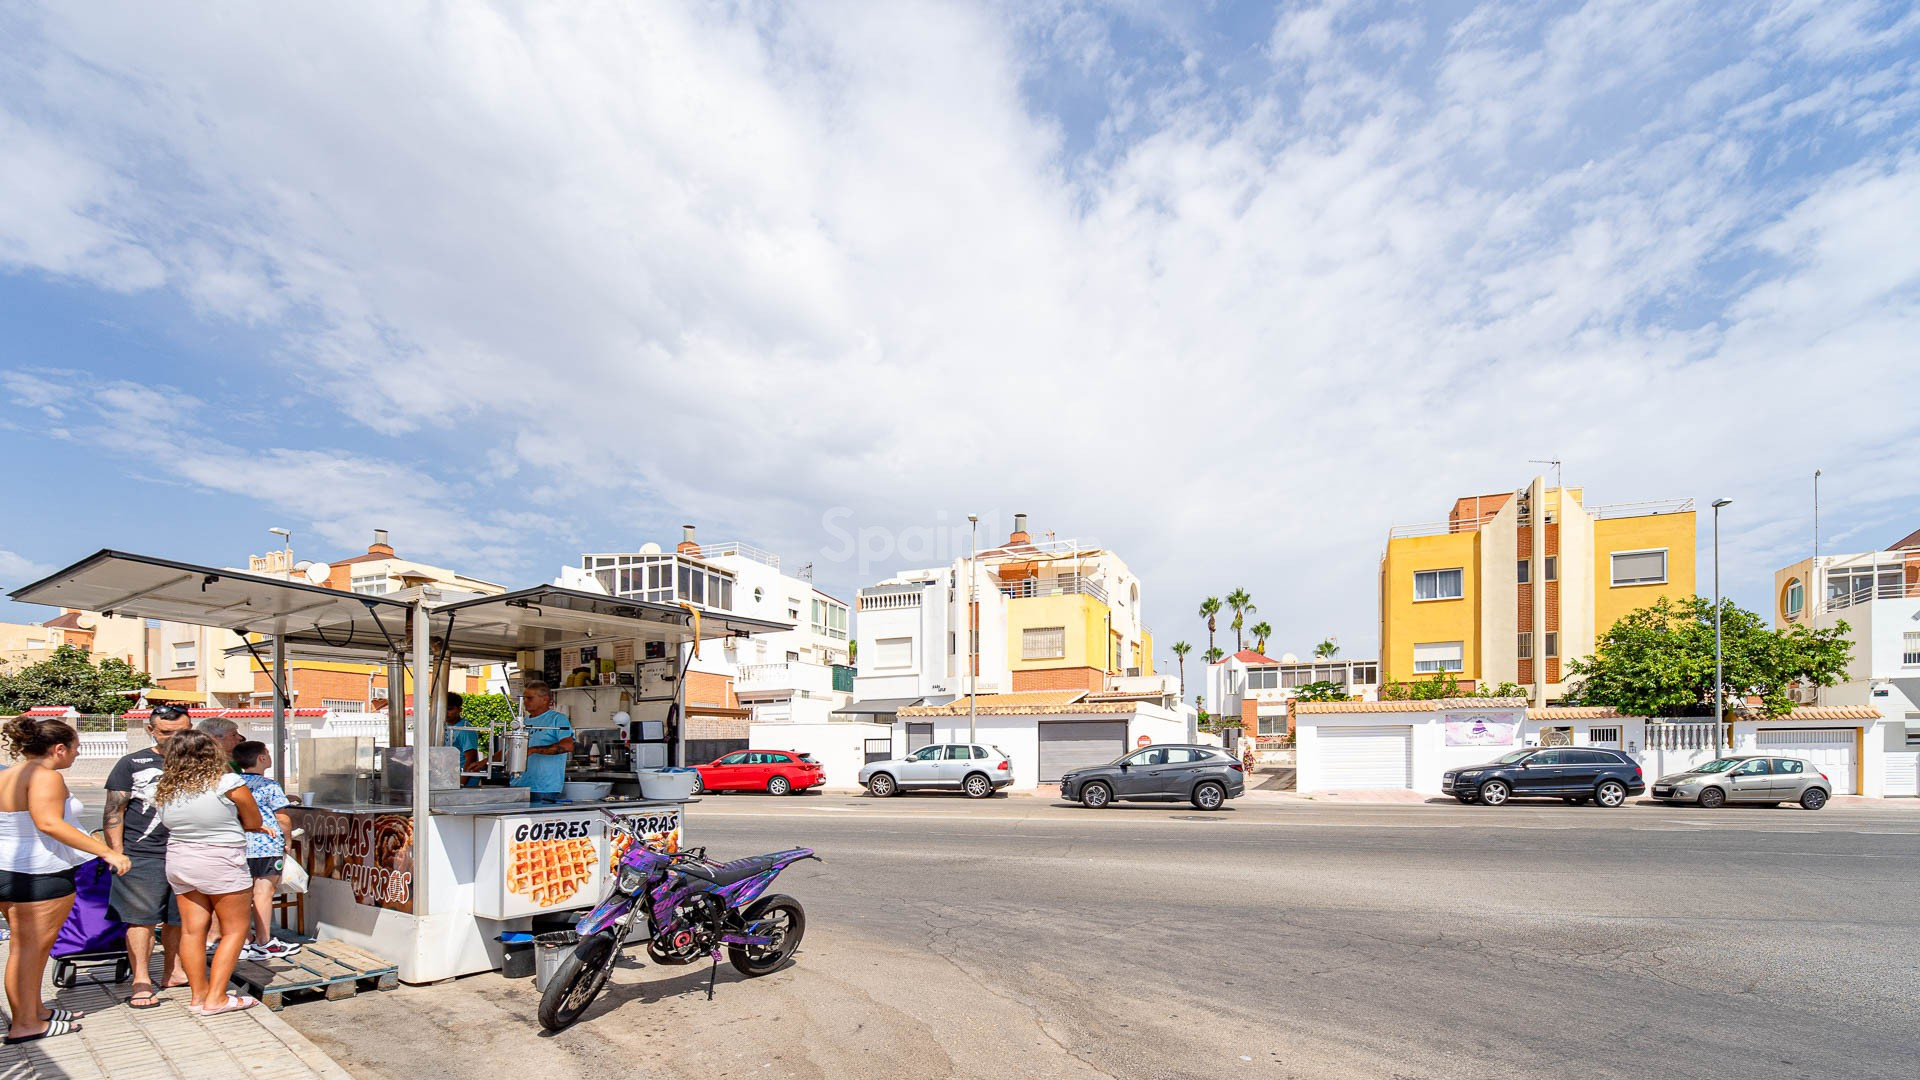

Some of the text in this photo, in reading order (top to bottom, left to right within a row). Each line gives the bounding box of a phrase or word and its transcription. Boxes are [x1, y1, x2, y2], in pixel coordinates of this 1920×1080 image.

[303, 814, 372, 858] PORRAS
[515, 820, 591, 842] GOFRES
[341, 863, 412, 904] CHURROS
